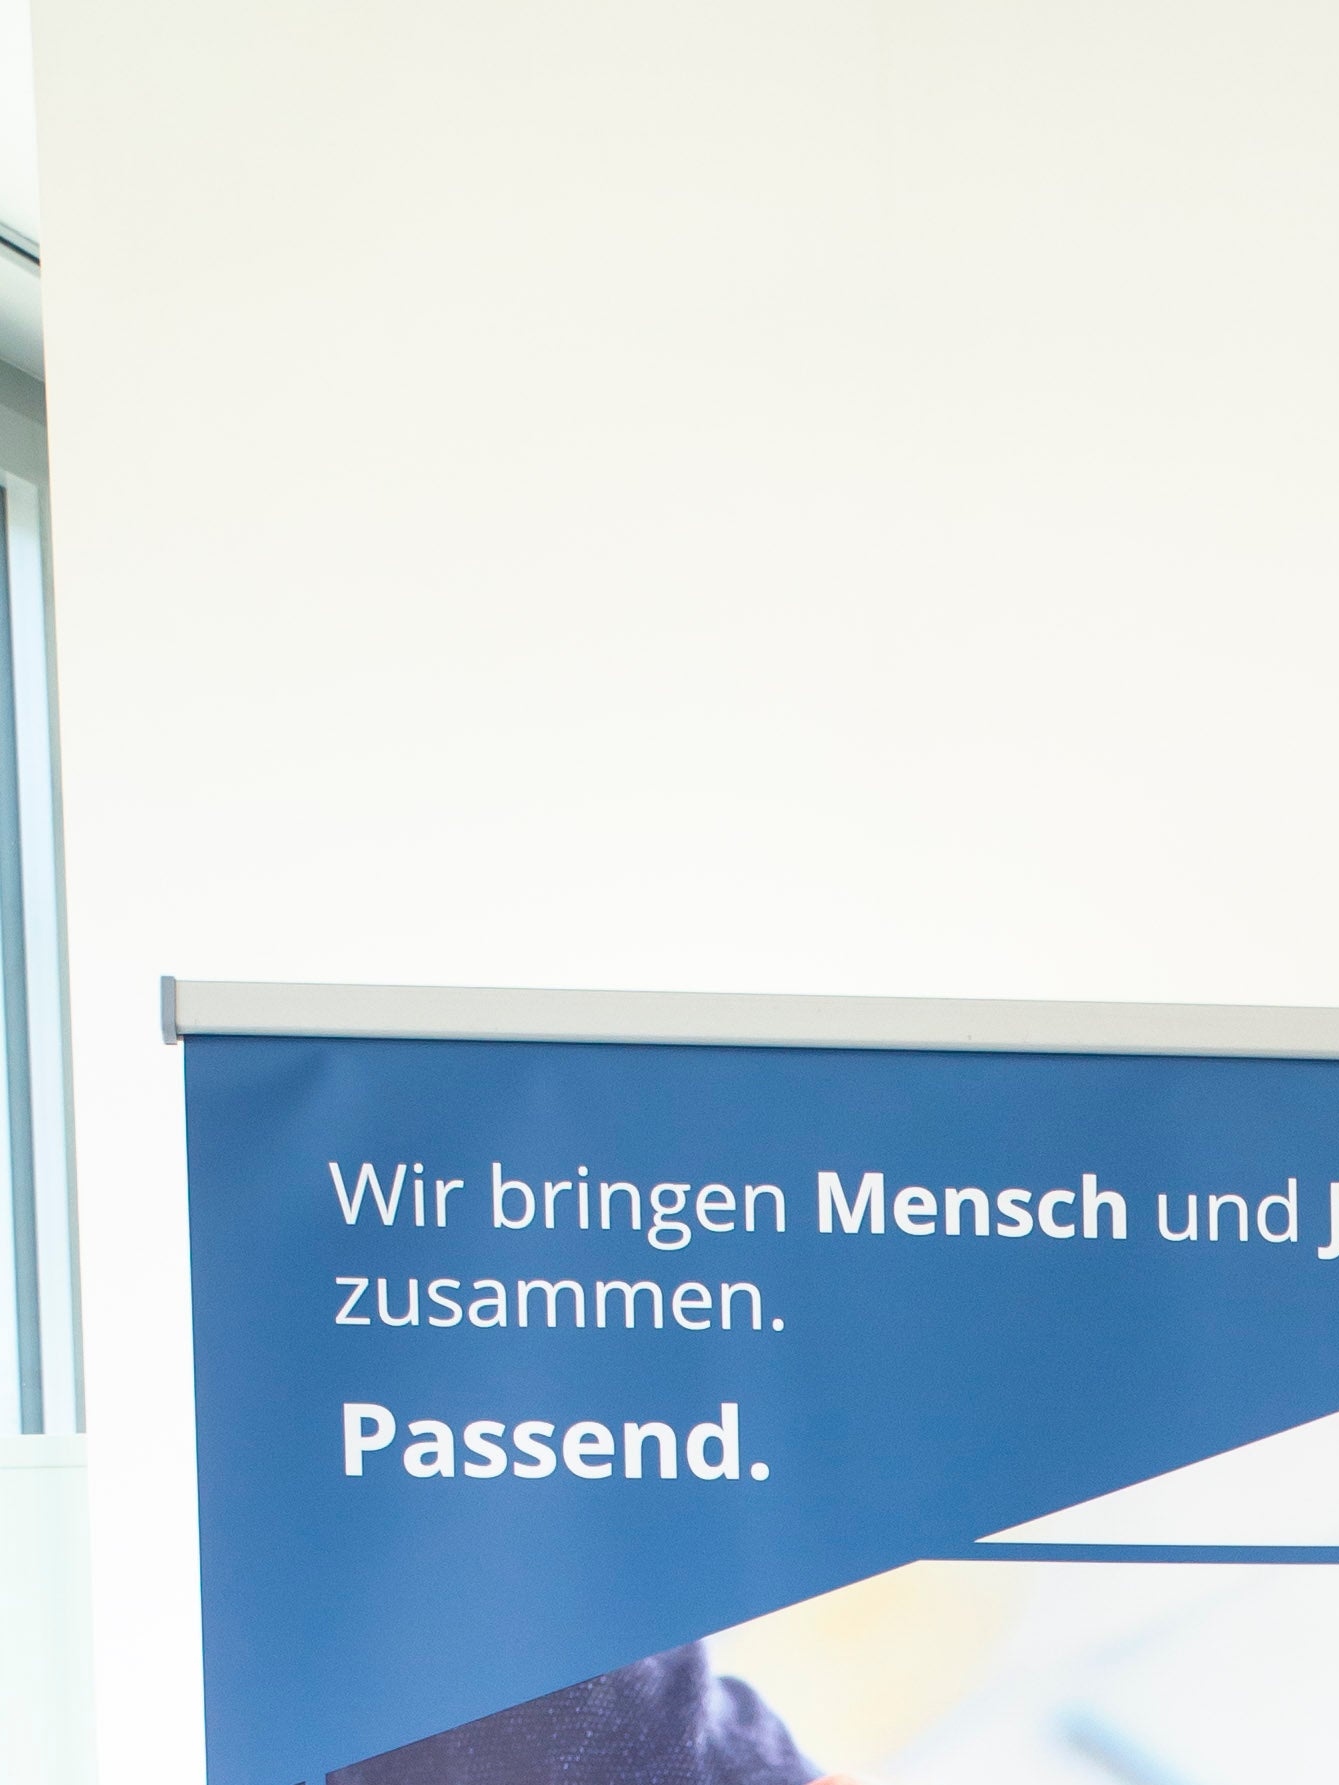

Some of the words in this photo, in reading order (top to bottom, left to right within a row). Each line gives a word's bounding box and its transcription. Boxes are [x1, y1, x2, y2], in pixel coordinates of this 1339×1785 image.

[328, 1161, 465, 1228] Wir
[491, 1162, 787, 1251] bringen
[816, 1171, 1127, 1240] Mensch
[1157, 1177, 1299, 1243] und
[335, 1275, 786, 1333] zusammen.
[342, 1402, 771, 1481] Passend.
